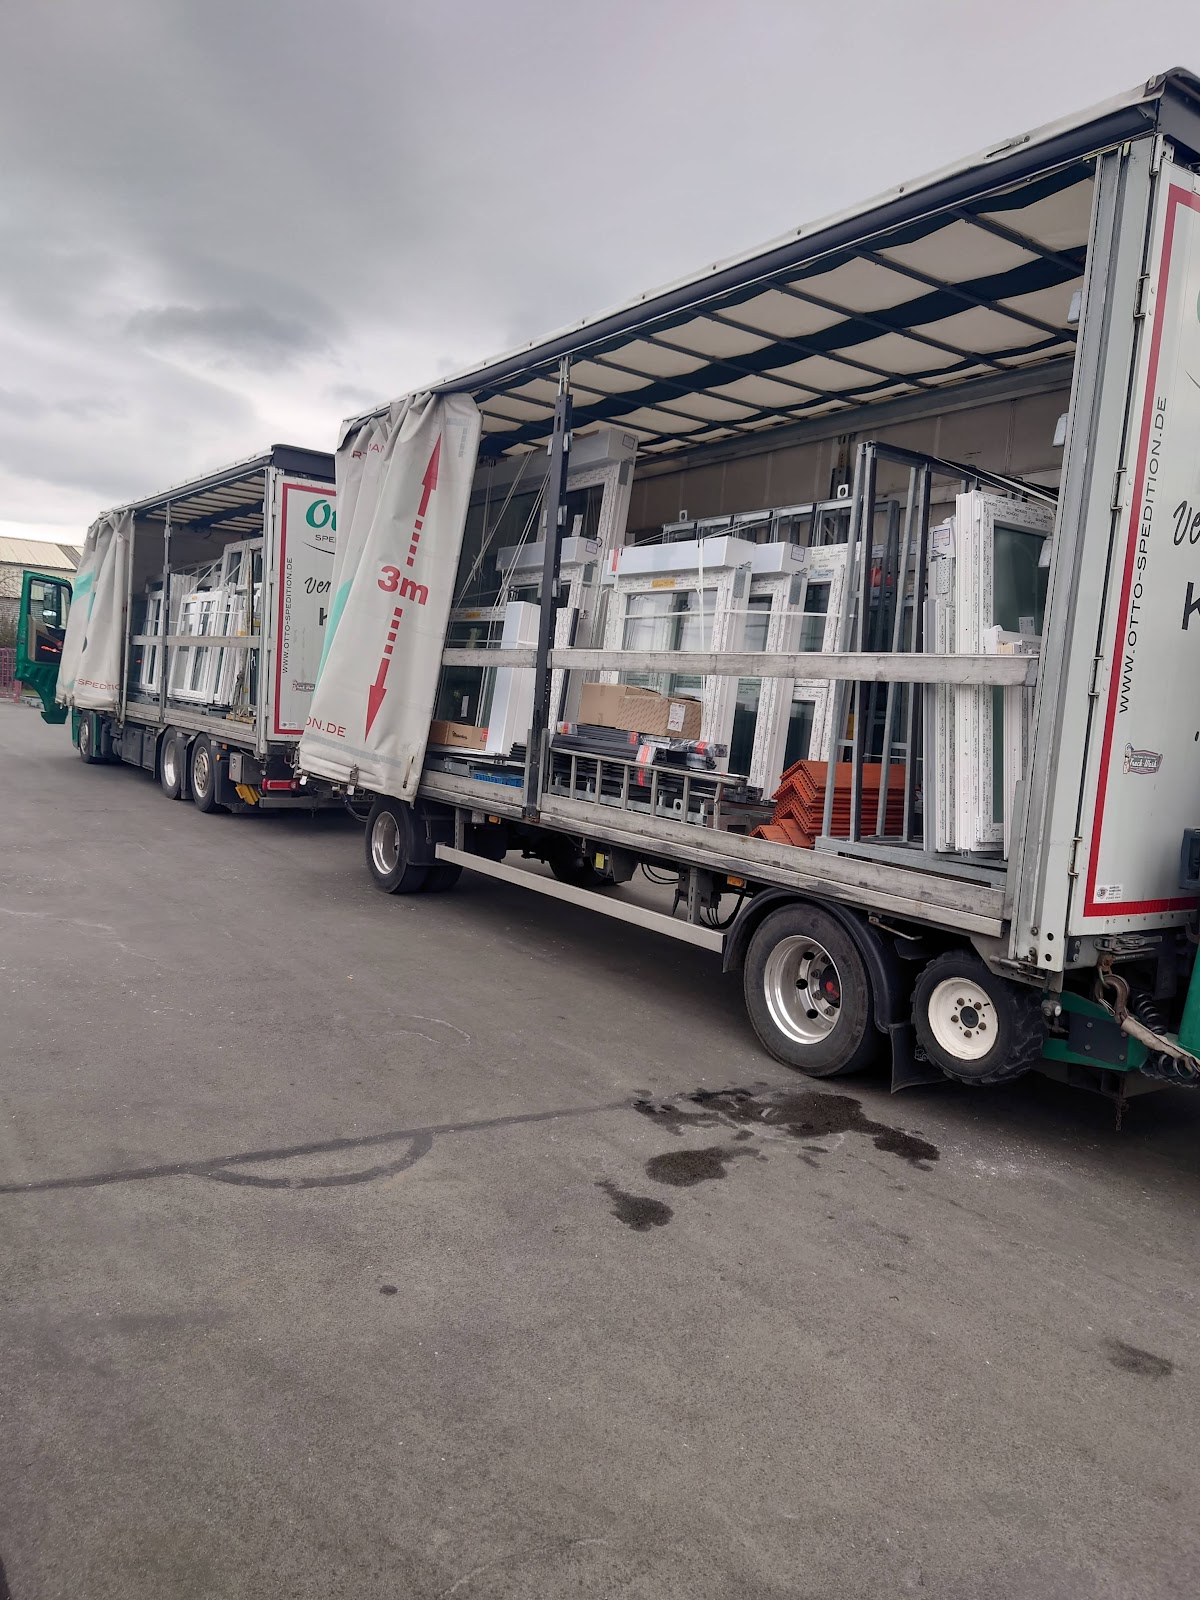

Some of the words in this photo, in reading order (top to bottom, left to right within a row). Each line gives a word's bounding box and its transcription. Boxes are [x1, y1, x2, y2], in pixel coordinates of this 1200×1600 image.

[315, 534, 336, 544] SPE
[1119, 396, 1167, 714] WWW.OTTO-SPEDITION.DE
[282, 557, 293, 674] WWW.OTTO-SPEDITION.DE
[377, 565, 429, 606] 3m
